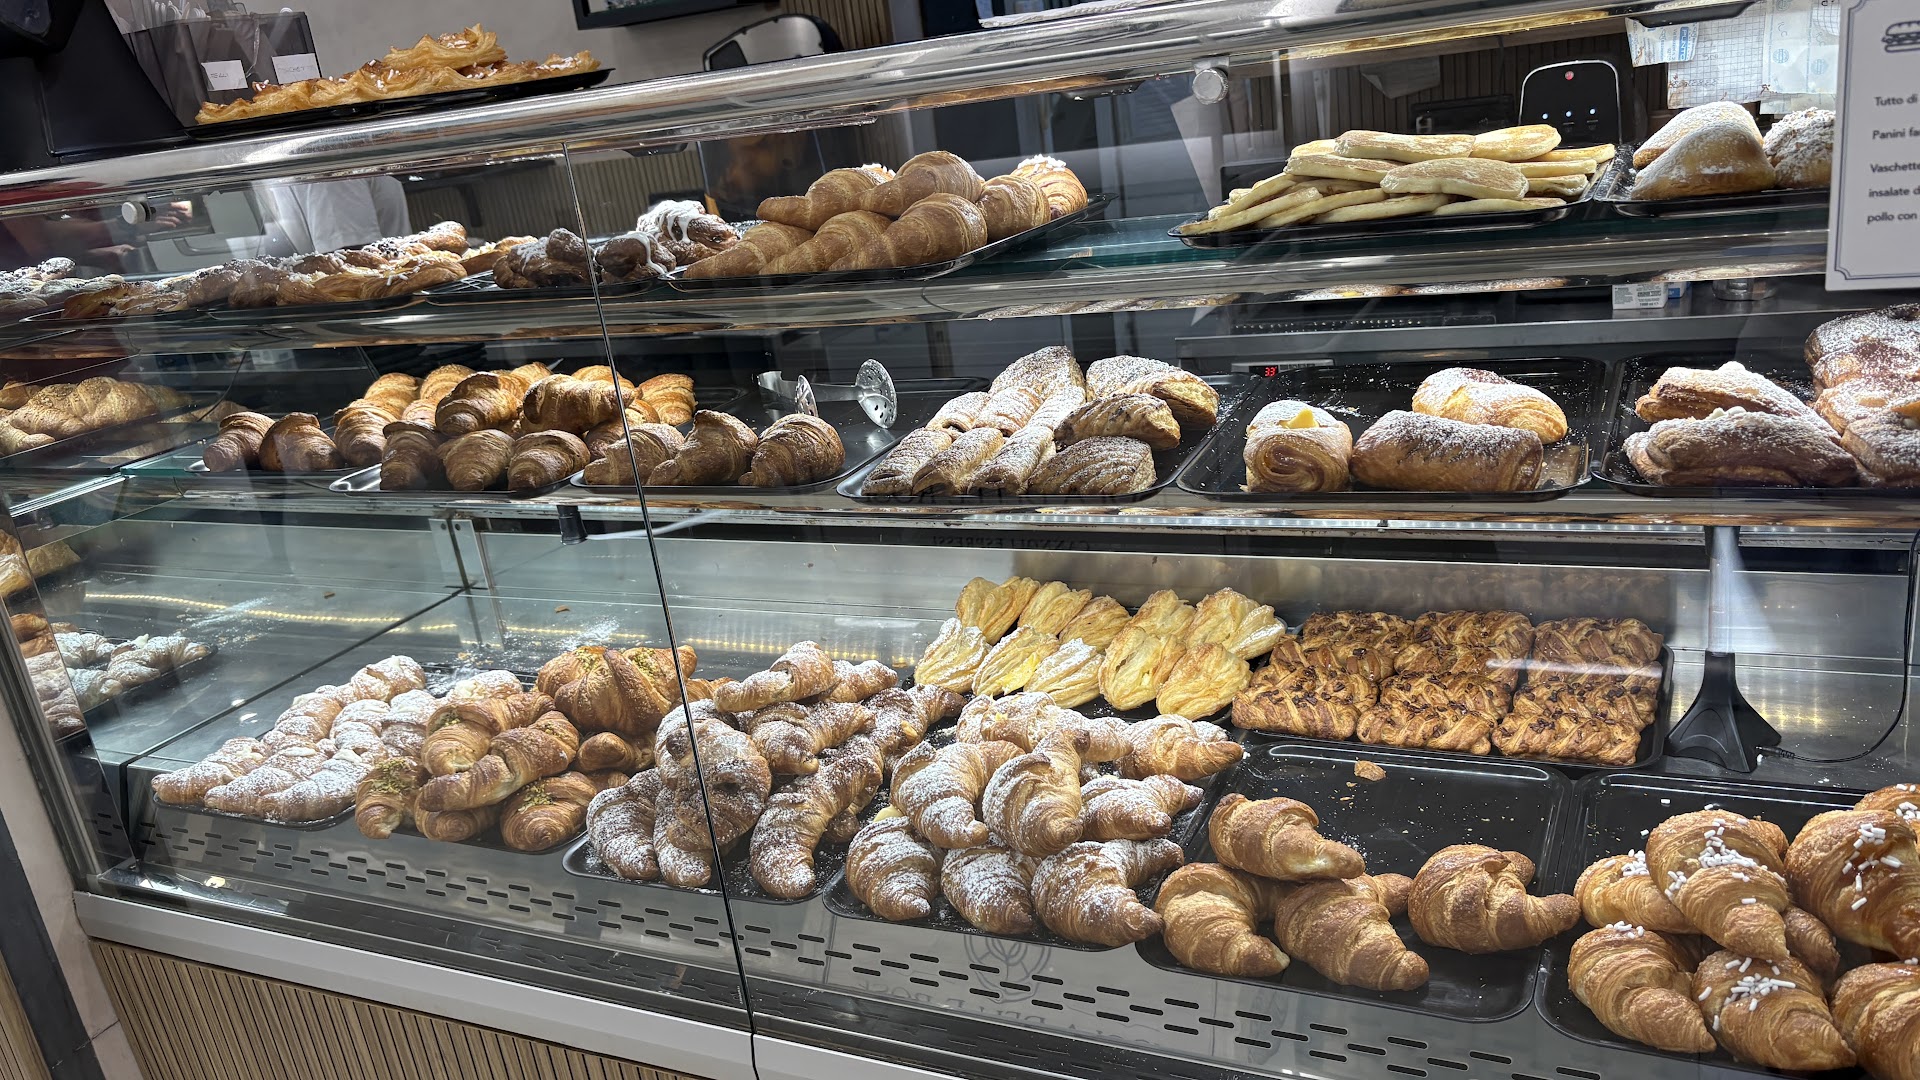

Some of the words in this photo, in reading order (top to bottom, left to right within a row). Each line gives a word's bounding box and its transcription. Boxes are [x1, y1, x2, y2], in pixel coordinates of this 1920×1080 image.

[1874, 96, 1904, 107] Tutto
[1906, 93, 1919, 104] di
[1872, 128, 1906, 140] Panini
[1868, 186, 1910, 198] insalate
[1866, 212, 1895, 225] pollo
[1897, 212, 1918, 221] con
